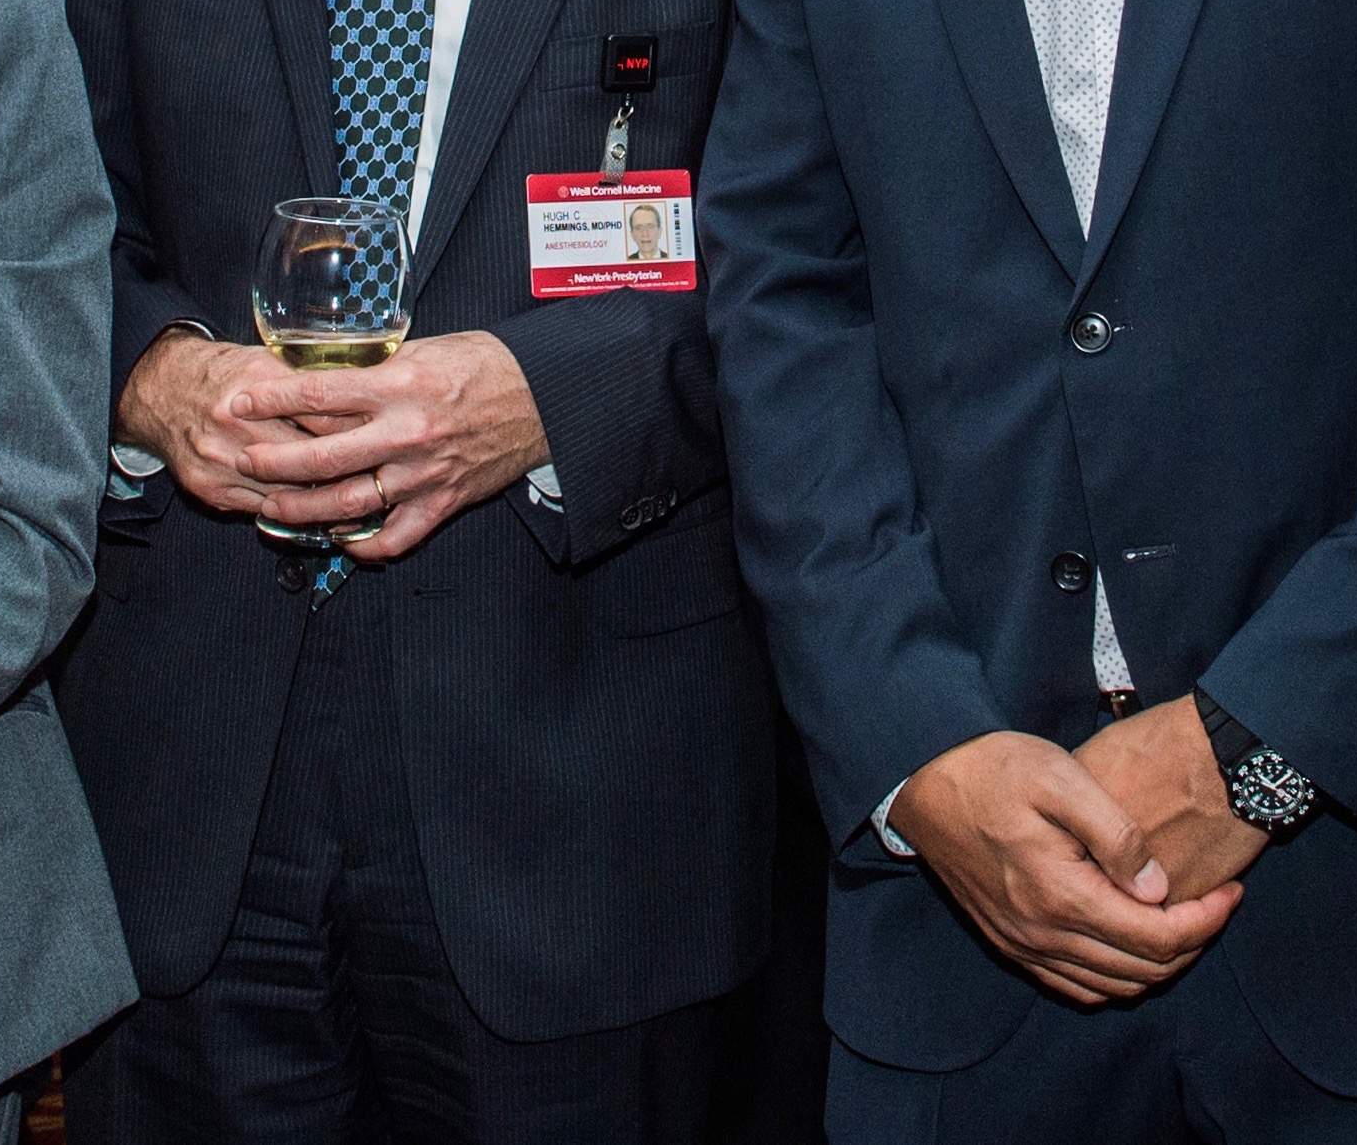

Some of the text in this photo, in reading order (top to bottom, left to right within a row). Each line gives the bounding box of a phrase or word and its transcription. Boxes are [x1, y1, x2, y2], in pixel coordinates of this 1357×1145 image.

[626, 58, 649, 69] NYP
[591, 185, 623, 196] Cornell
[623, 184, 662, 195] Medicine
[543, 210, 581, 221] HUGH C
[591, 221, 623, 231] MD/PHD
